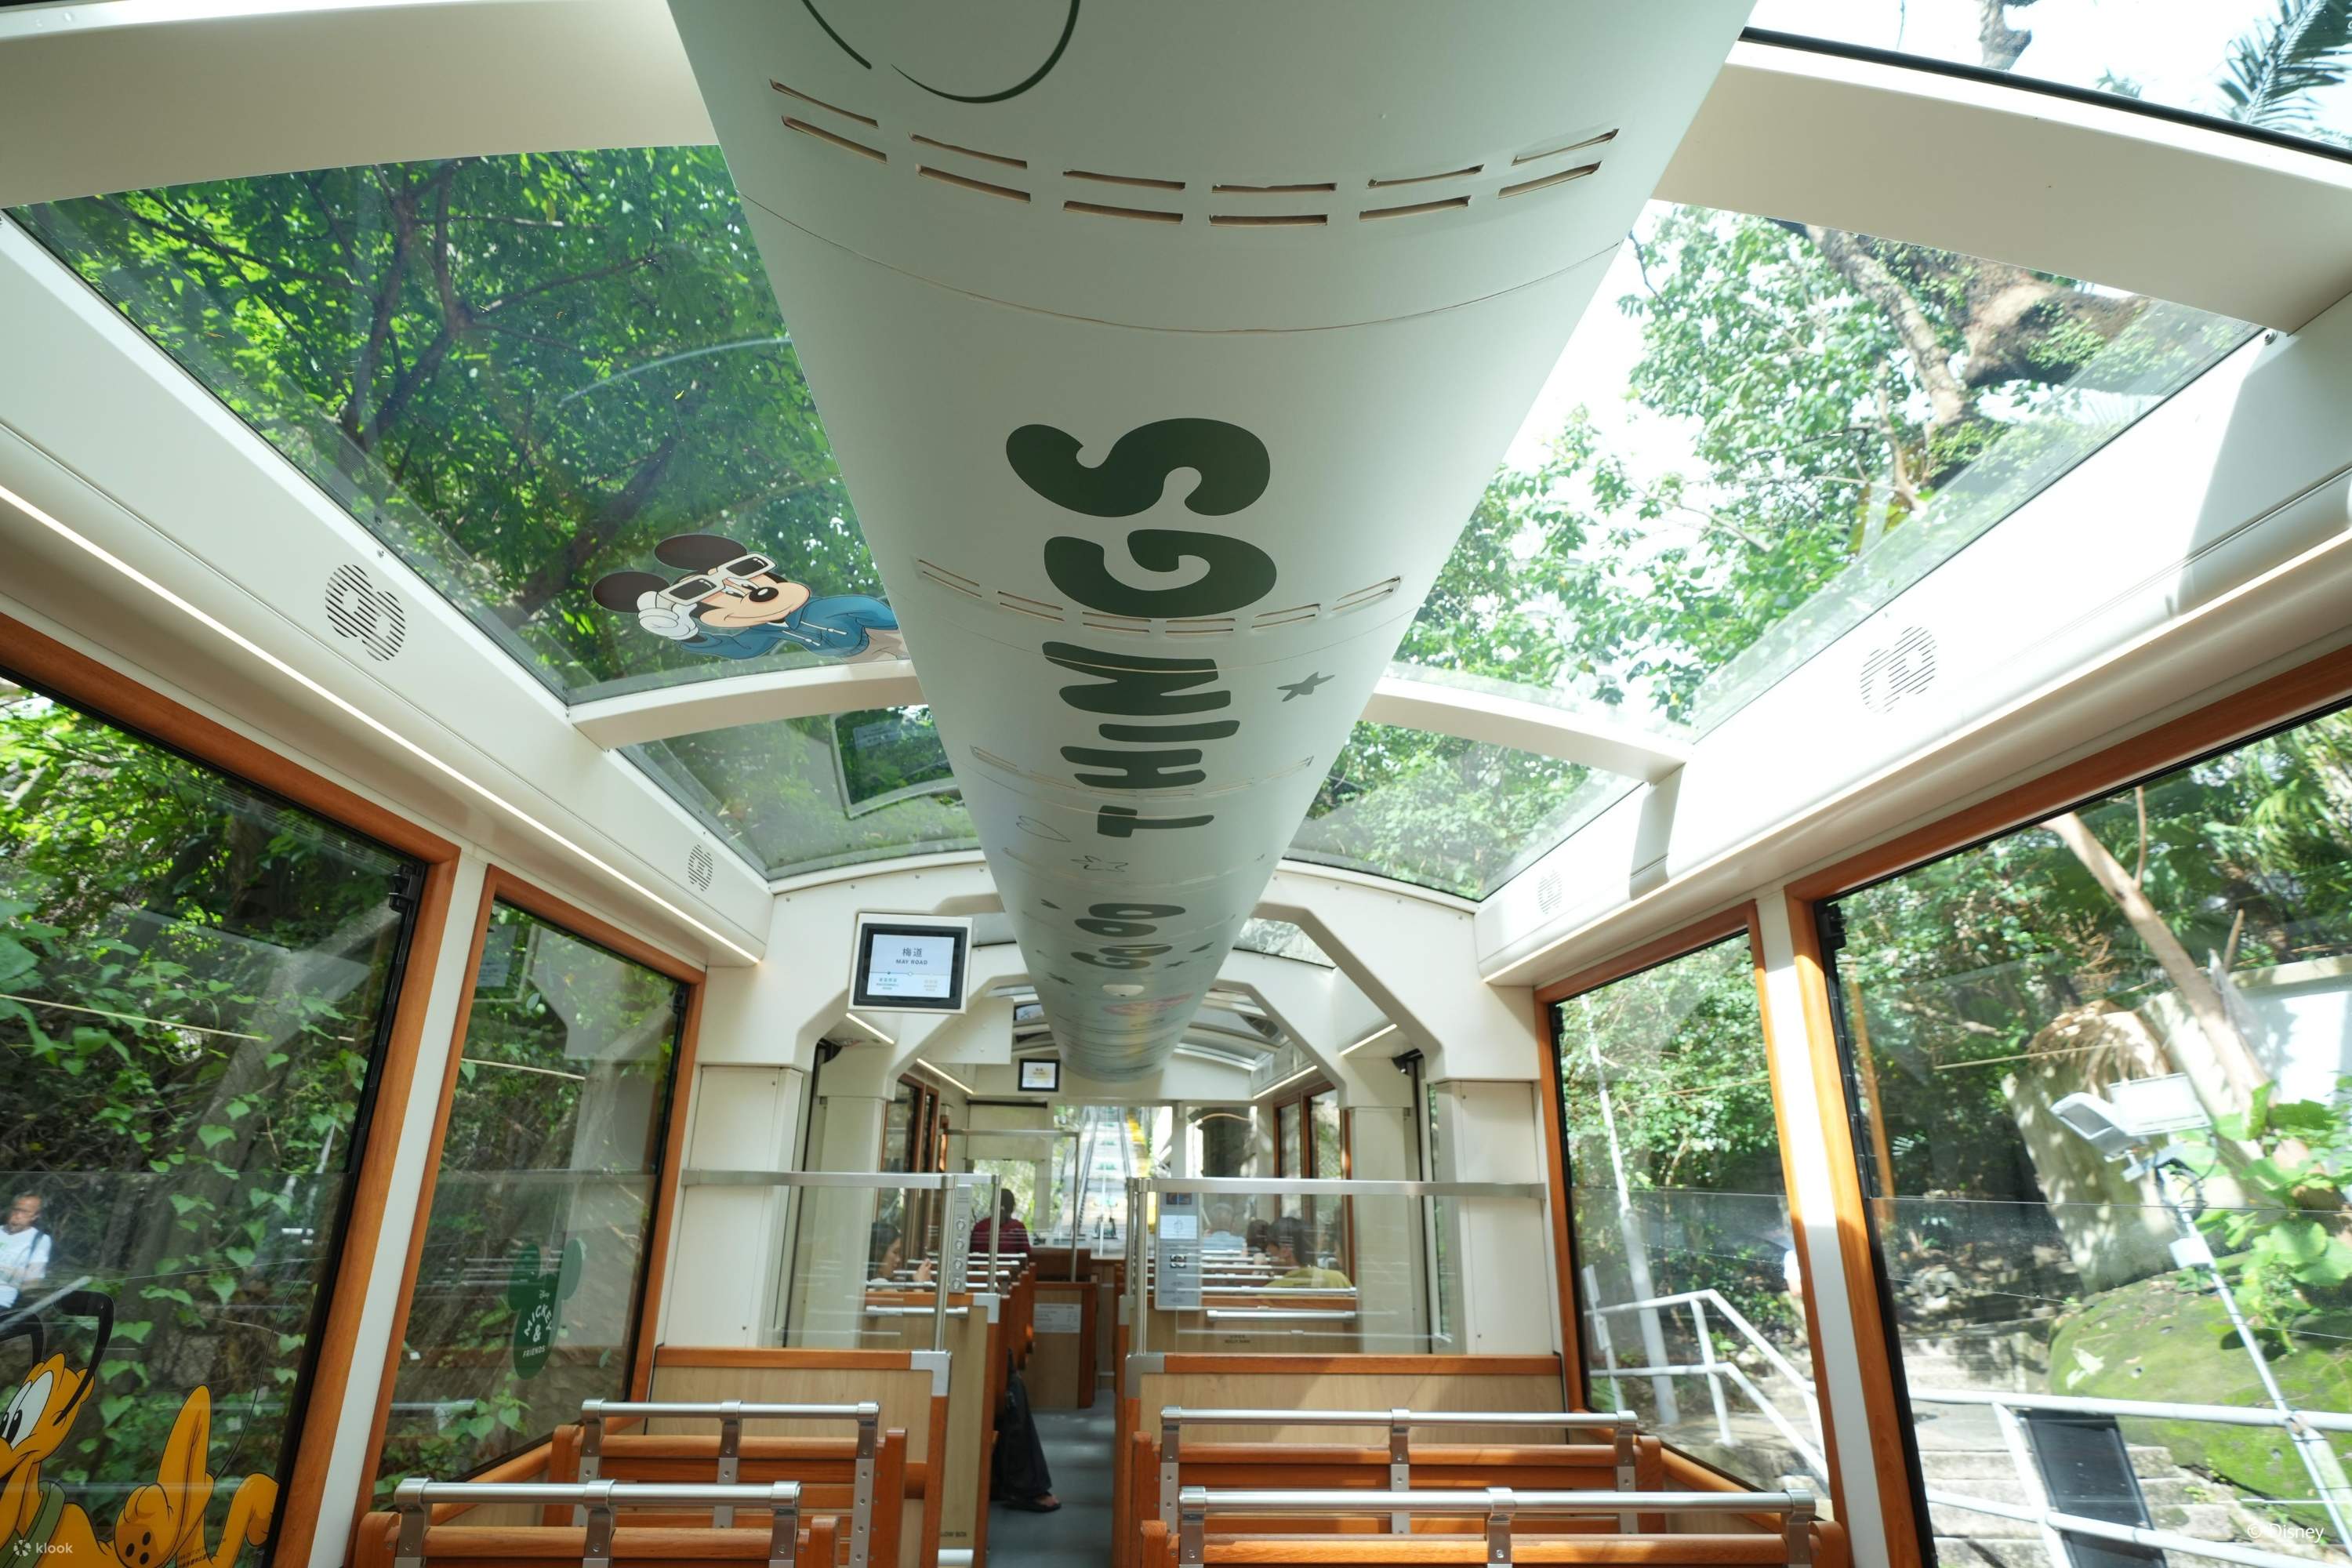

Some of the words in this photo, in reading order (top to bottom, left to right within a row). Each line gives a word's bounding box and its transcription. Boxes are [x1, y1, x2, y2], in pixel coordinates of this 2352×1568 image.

[1006, 417, 1277, 838] THINGS
[1070, 902, 1185, 969] GOOD
[902, 947, 923, 957] 梅道
[524, 1304, 552, 1337] MICKEY
[532, 1324, 541, 1342] &
[522, 1345, 546, 1359] FRIENDS
